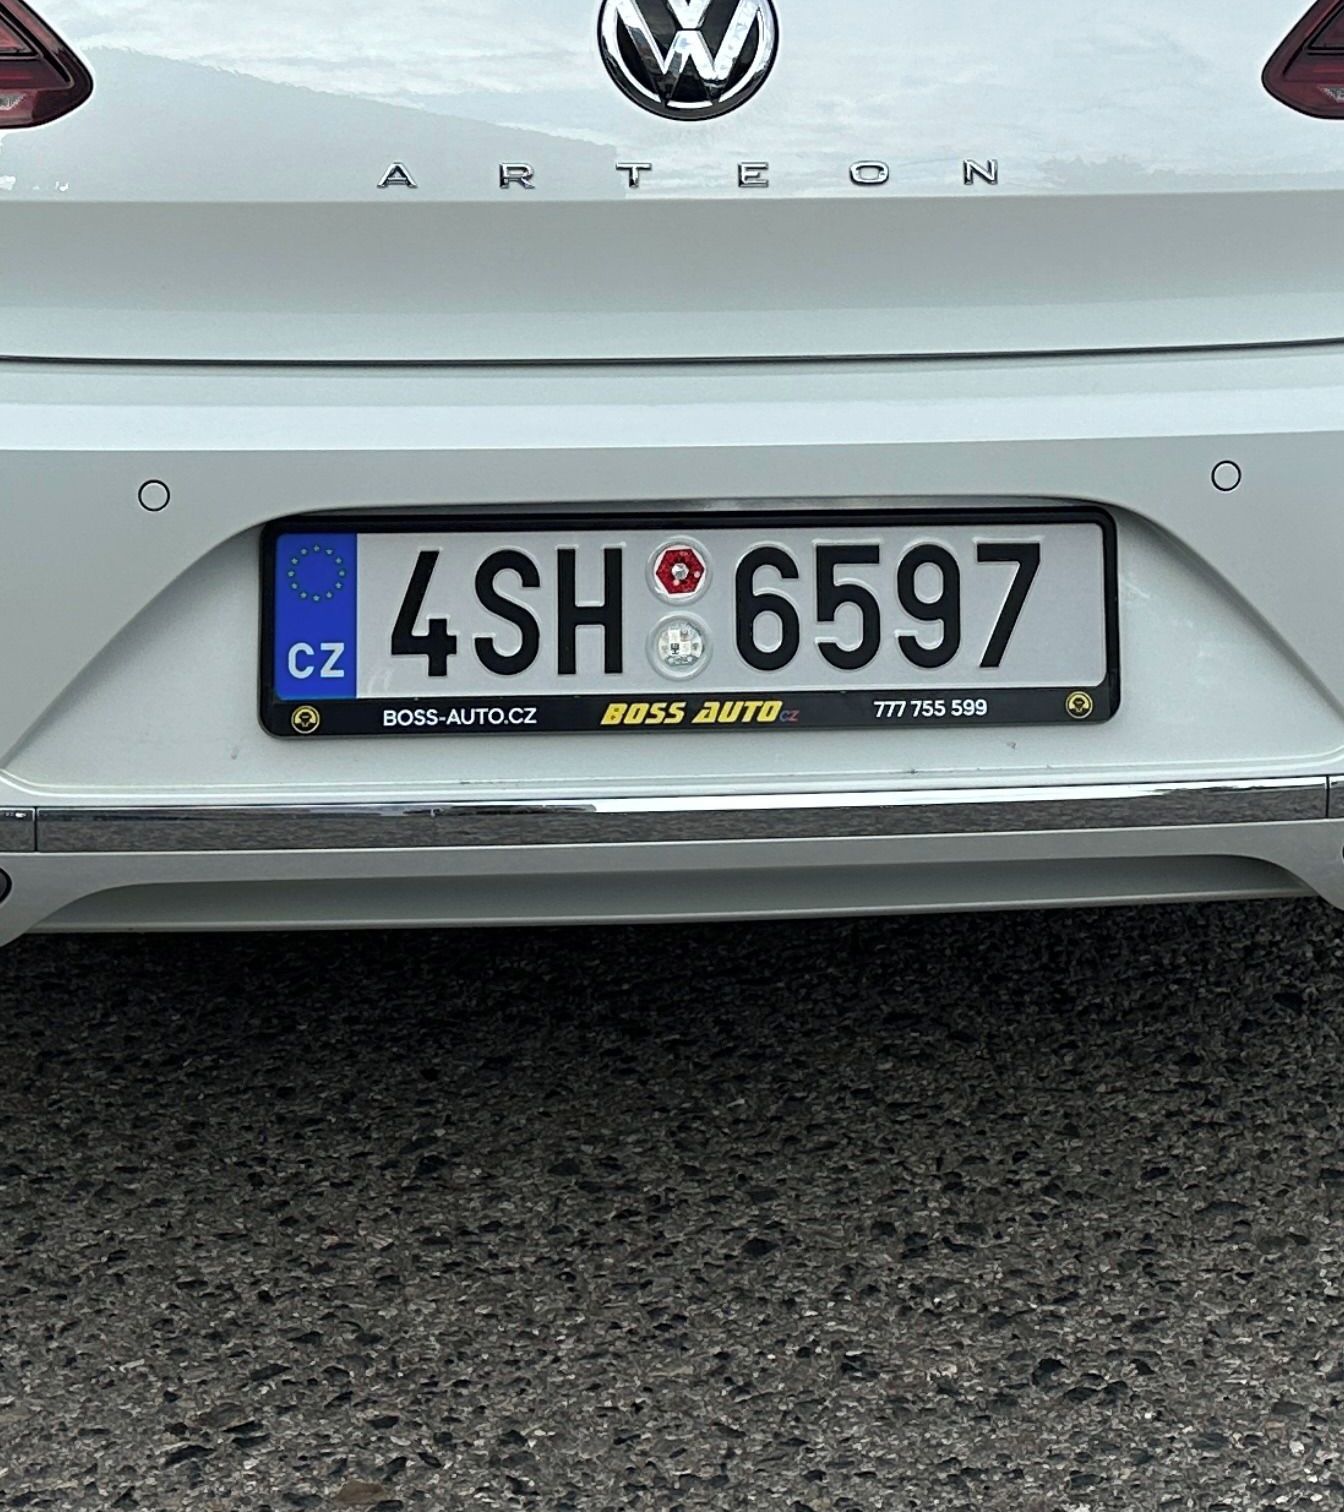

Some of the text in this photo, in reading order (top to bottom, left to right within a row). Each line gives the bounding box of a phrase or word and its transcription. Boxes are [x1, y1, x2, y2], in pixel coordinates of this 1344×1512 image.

[376, 159, 1000, 188] ARTEON
[391, 543, 1041, 676] 4SH 6597
[288, 642, 345, 679] CZ
[383, 706, 537, 727] BOSS-AUTO.CZ
[600, 701, 686, 725] BOSS
[691, 700, 783, 724] AUTO
[873, 698, 989, 719] 777 755 599
